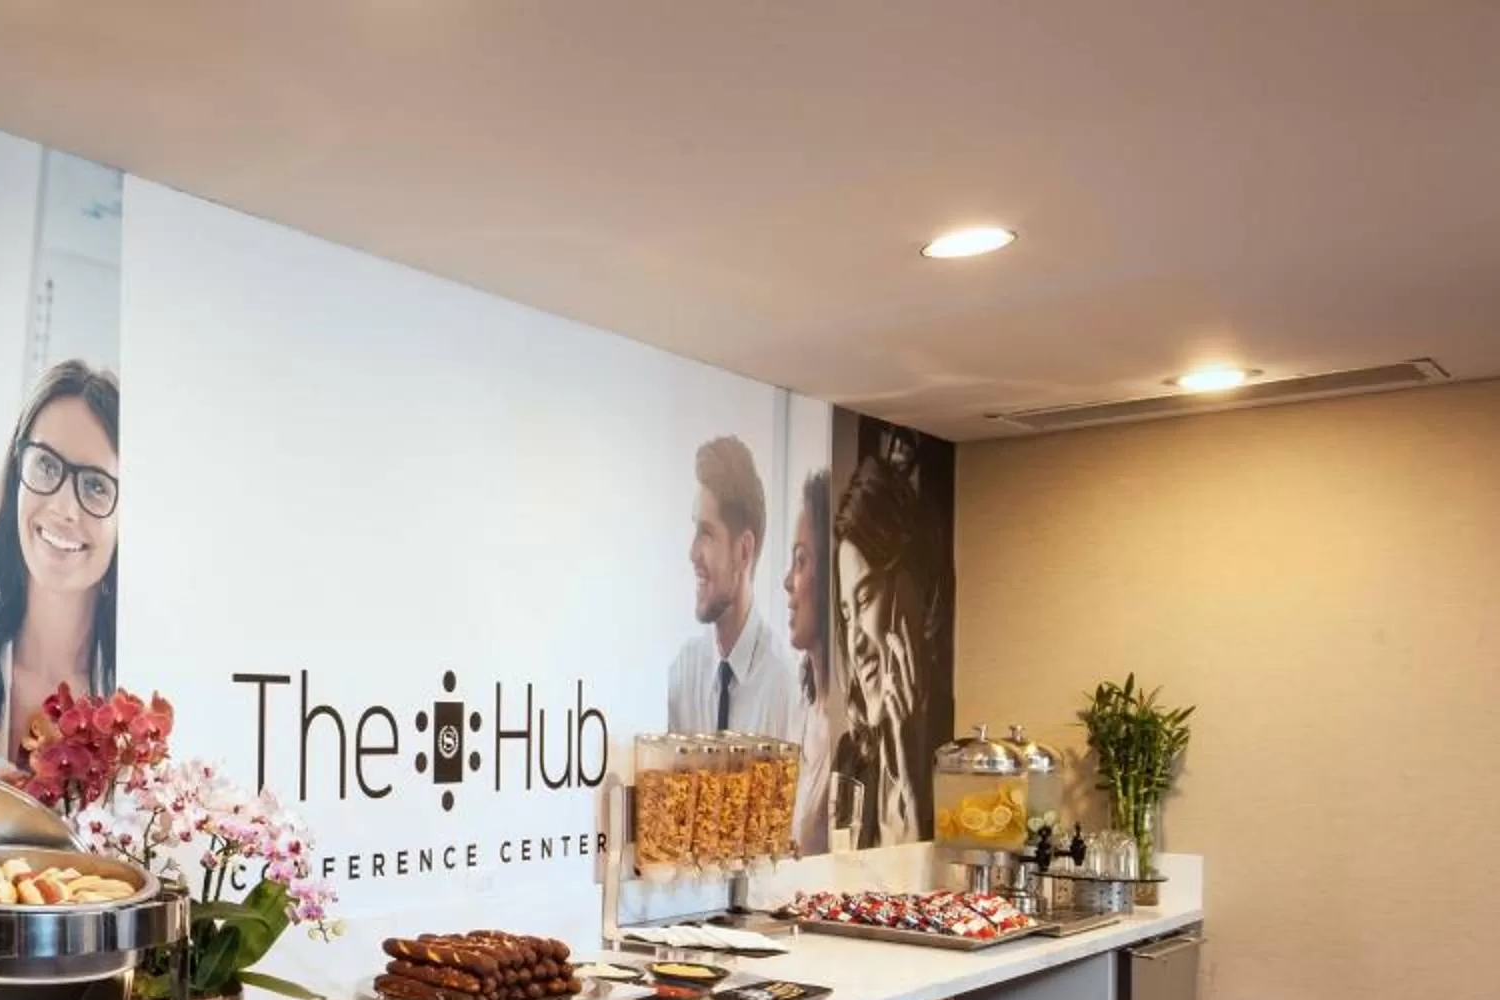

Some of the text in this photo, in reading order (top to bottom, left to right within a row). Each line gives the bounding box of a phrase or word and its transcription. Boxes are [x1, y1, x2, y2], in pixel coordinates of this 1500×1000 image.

[232, 669, 609, 801] The Hub
[231, 832, 607, 891] CFERENCE CENTER
